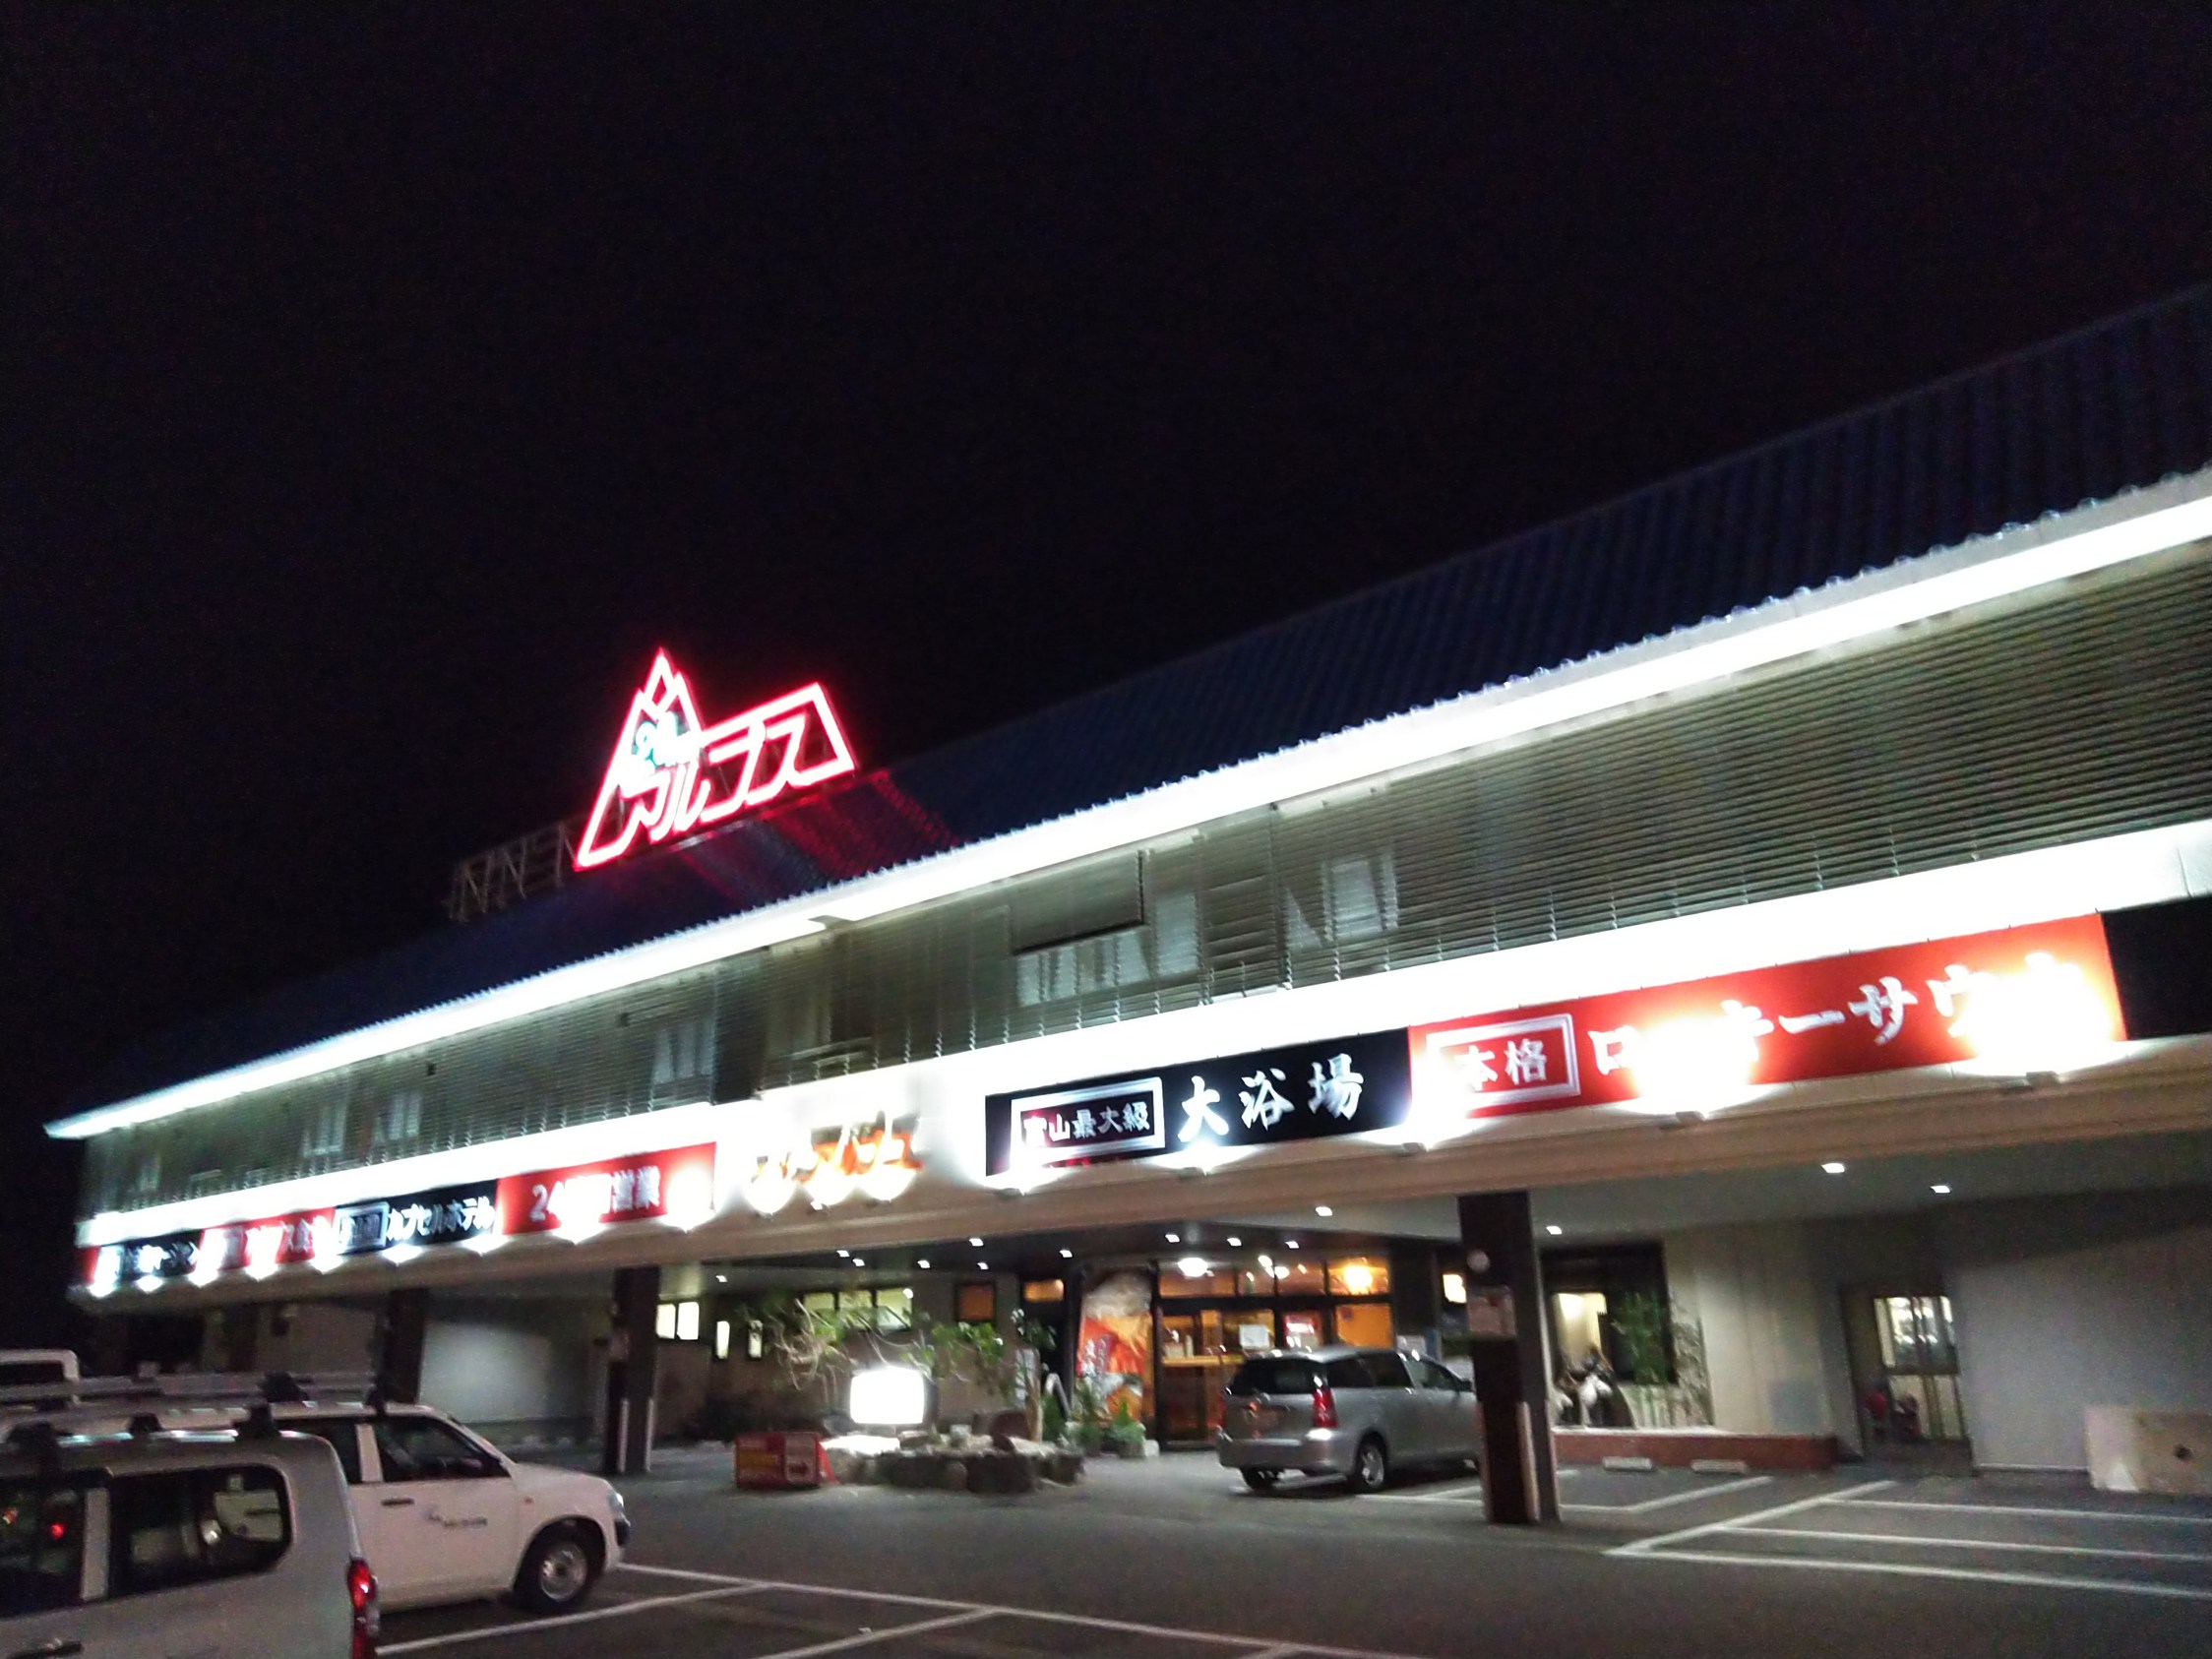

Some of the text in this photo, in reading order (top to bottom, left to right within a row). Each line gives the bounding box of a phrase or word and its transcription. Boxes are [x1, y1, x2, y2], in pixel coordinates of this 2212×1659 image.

[1177, 1052, 1365, 1141] 大浴場
[1452, 1038, 1547, 1092] 本格
